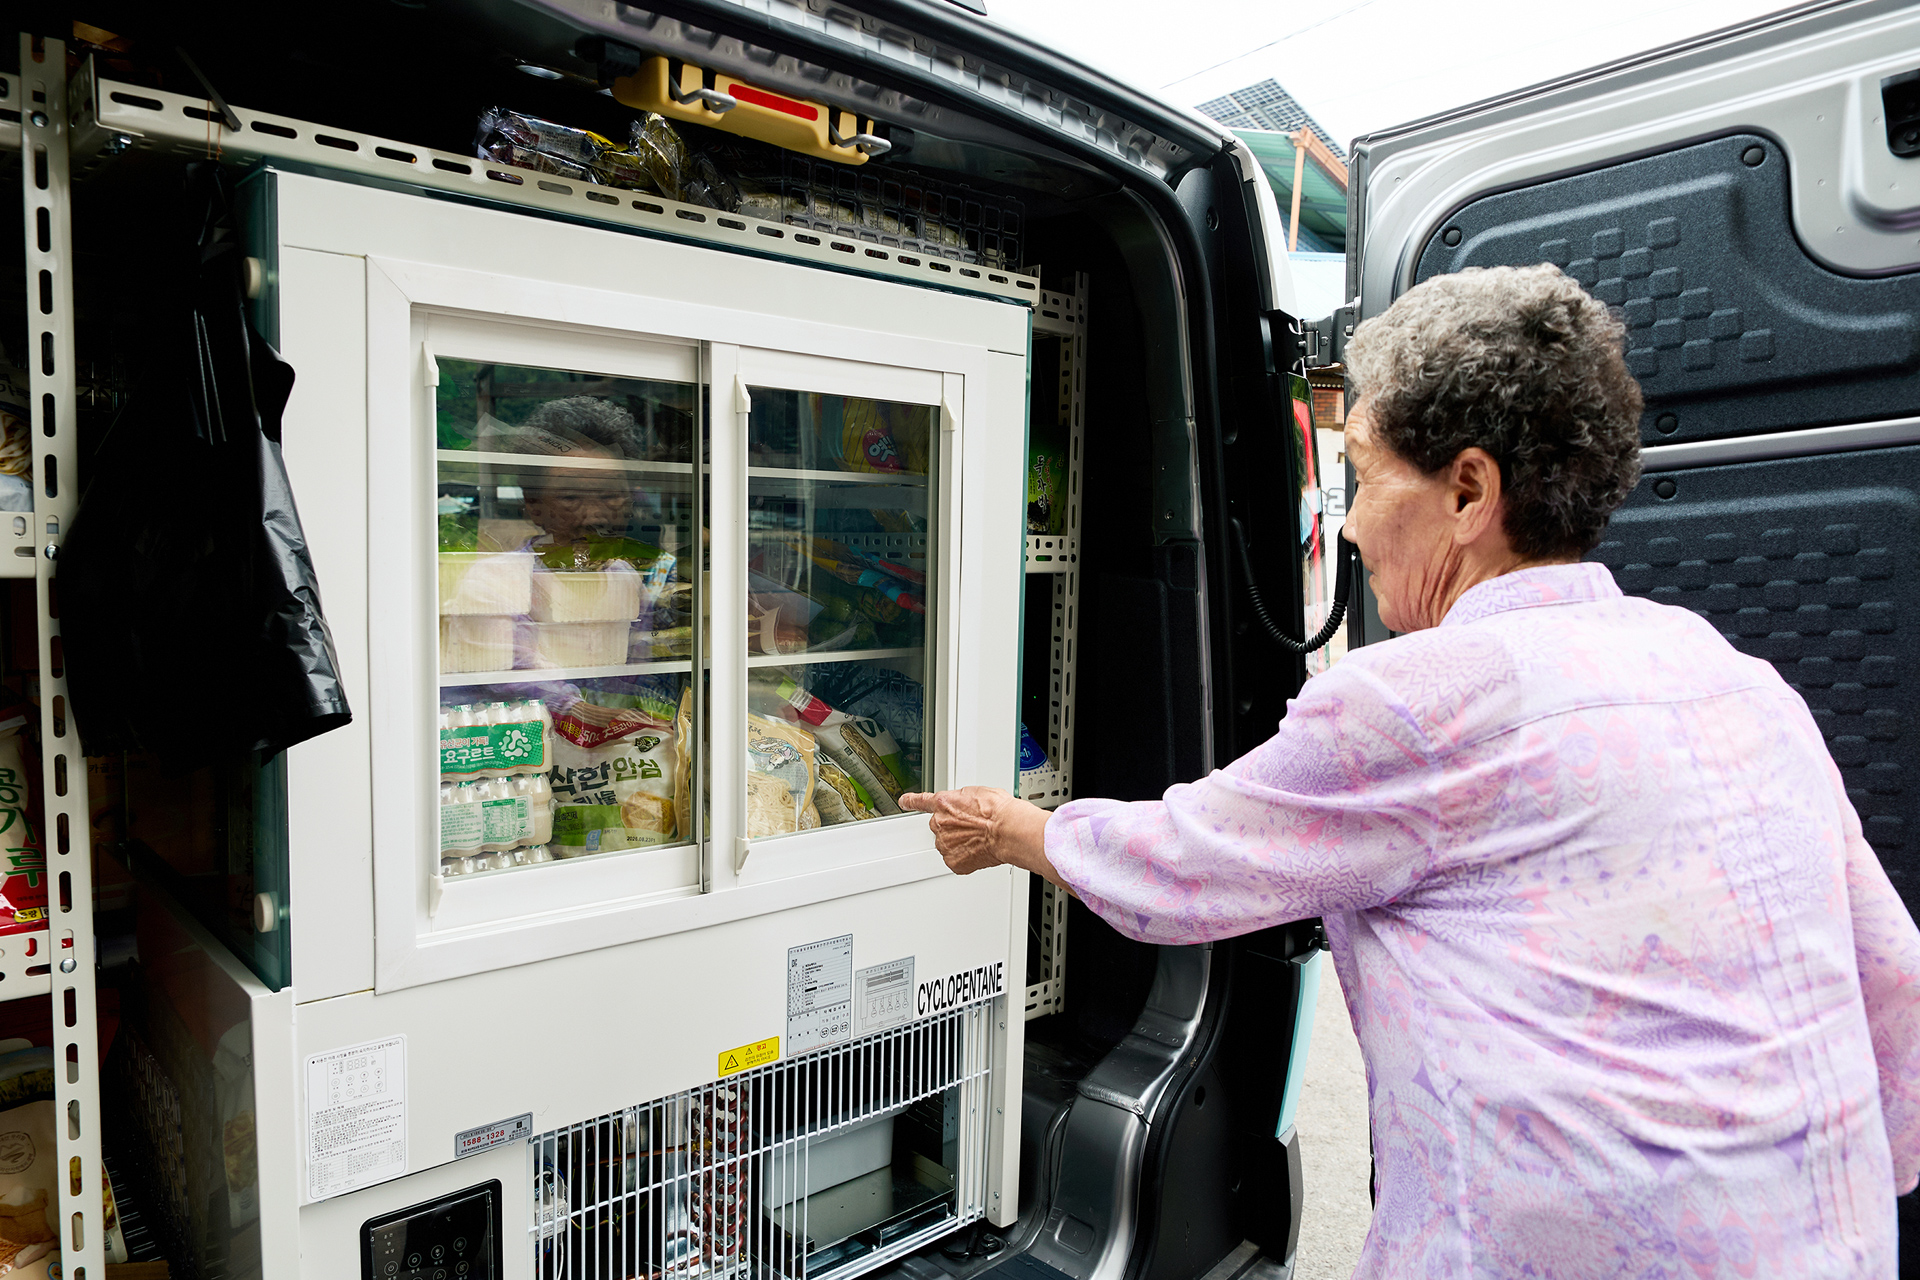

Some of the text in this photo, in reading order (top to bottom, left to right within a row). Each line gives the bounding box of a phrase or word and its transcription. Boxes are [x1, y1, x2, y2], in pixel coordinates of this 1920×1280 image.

[444, 747, 495, 765] 요구르트
[612, 757, 662, 782] 안심
[917, 962, 1003, 1016] CYCLOPENTANE
[462, 1130, 505, 1147] 1588-1328
